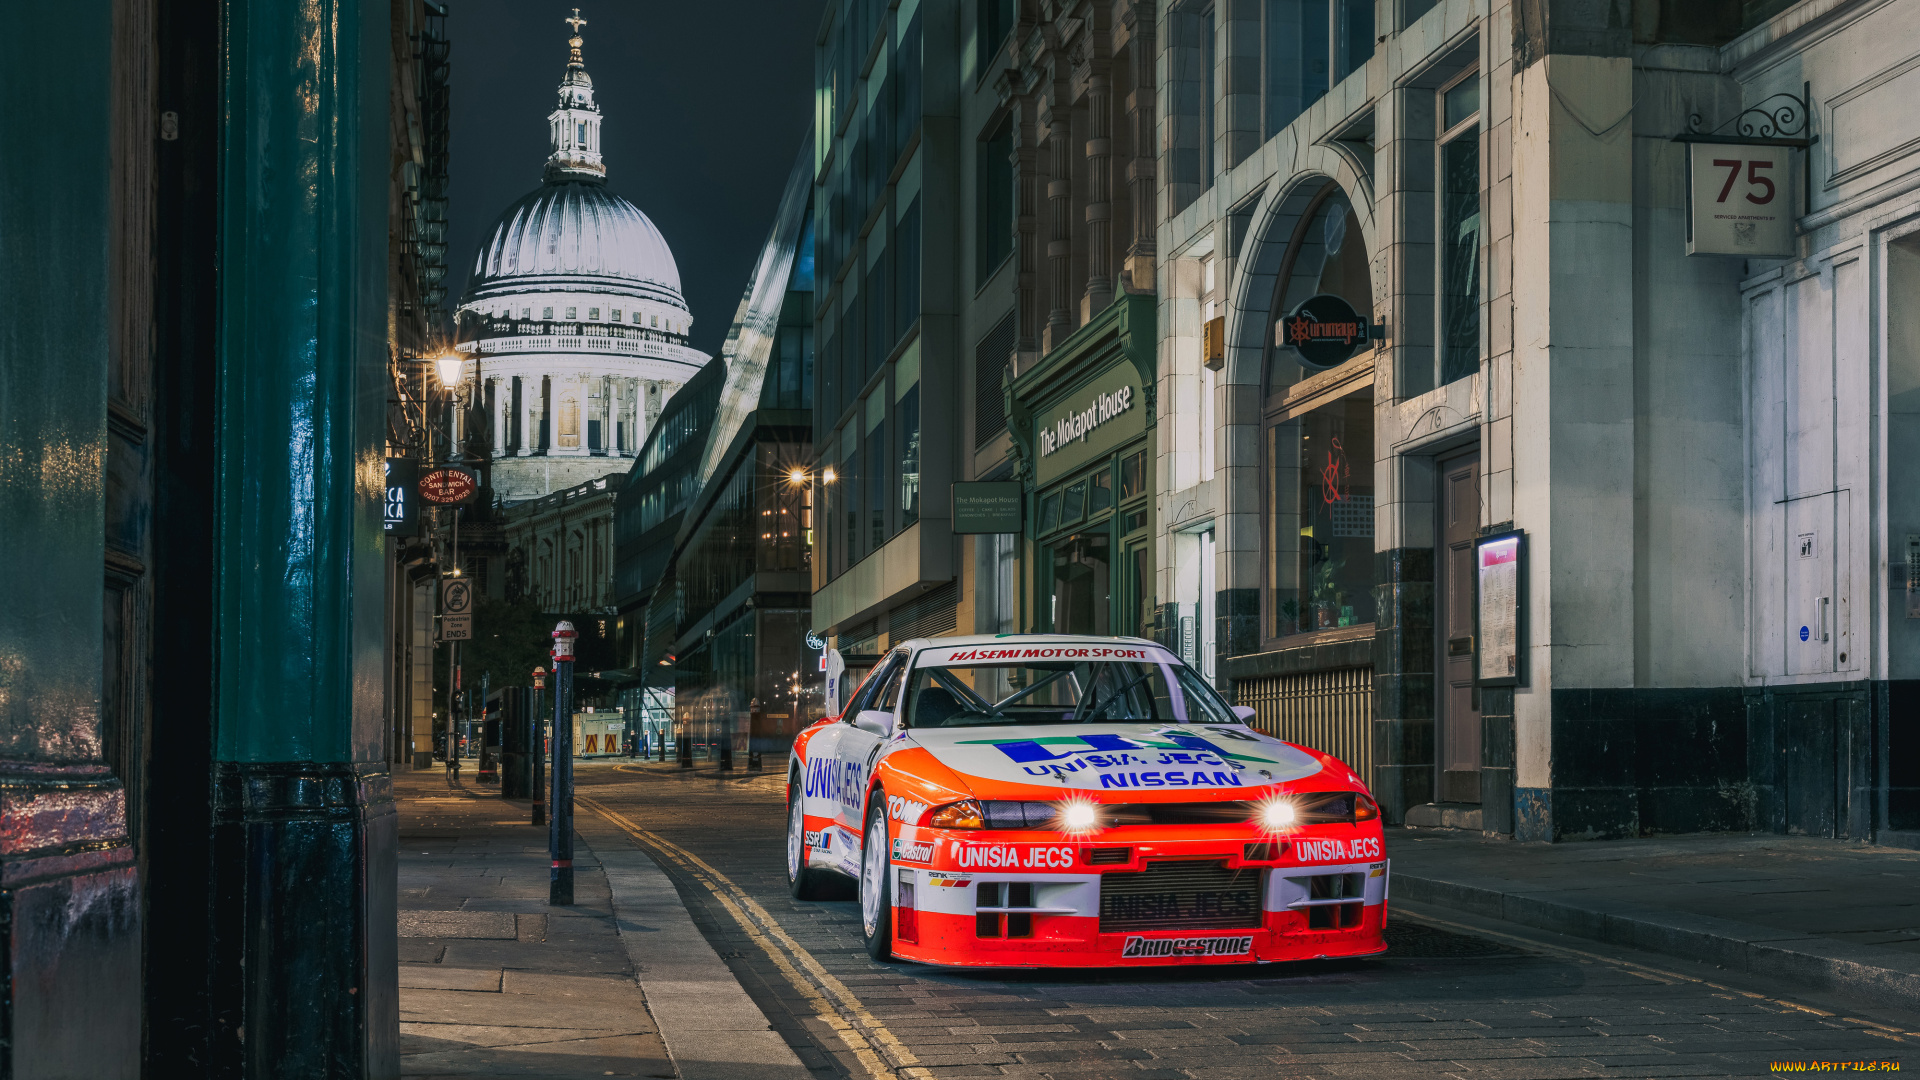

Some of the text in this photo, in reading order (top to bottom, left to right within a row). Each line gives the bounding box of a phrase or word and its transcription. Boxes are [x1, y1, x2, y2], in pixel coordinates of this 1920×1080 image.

[1713, 159, 1775, 205] 75
[1040, 385, 1130, 458] The Mokapot House
[420, 470, 472, 487] CONTINENTAL
[428, 480, 464, 489] SANDWICH
[438, 488, 455, 496] BAR
[969, 496, 998, 504] Mokapot
[446, 630, 467, 639] ENDS
[948, 649, 1021, 662] HASEMI
[805, 757, 862, 810] UNISIA JECS
[1099, 771, 1243, 789] NISSAN
[805, 830, 822, 848] SSR
[902, 842, 934, 863] Castrol
[958, 846, 1073, 869] UNISIA JECS
[1296, 837, 1380, 862] UNISIA JECS
[1101, 891, 1250, 919] UNISIA JECS
[1122, 936, 1253, 958] BRIDGESTONE
